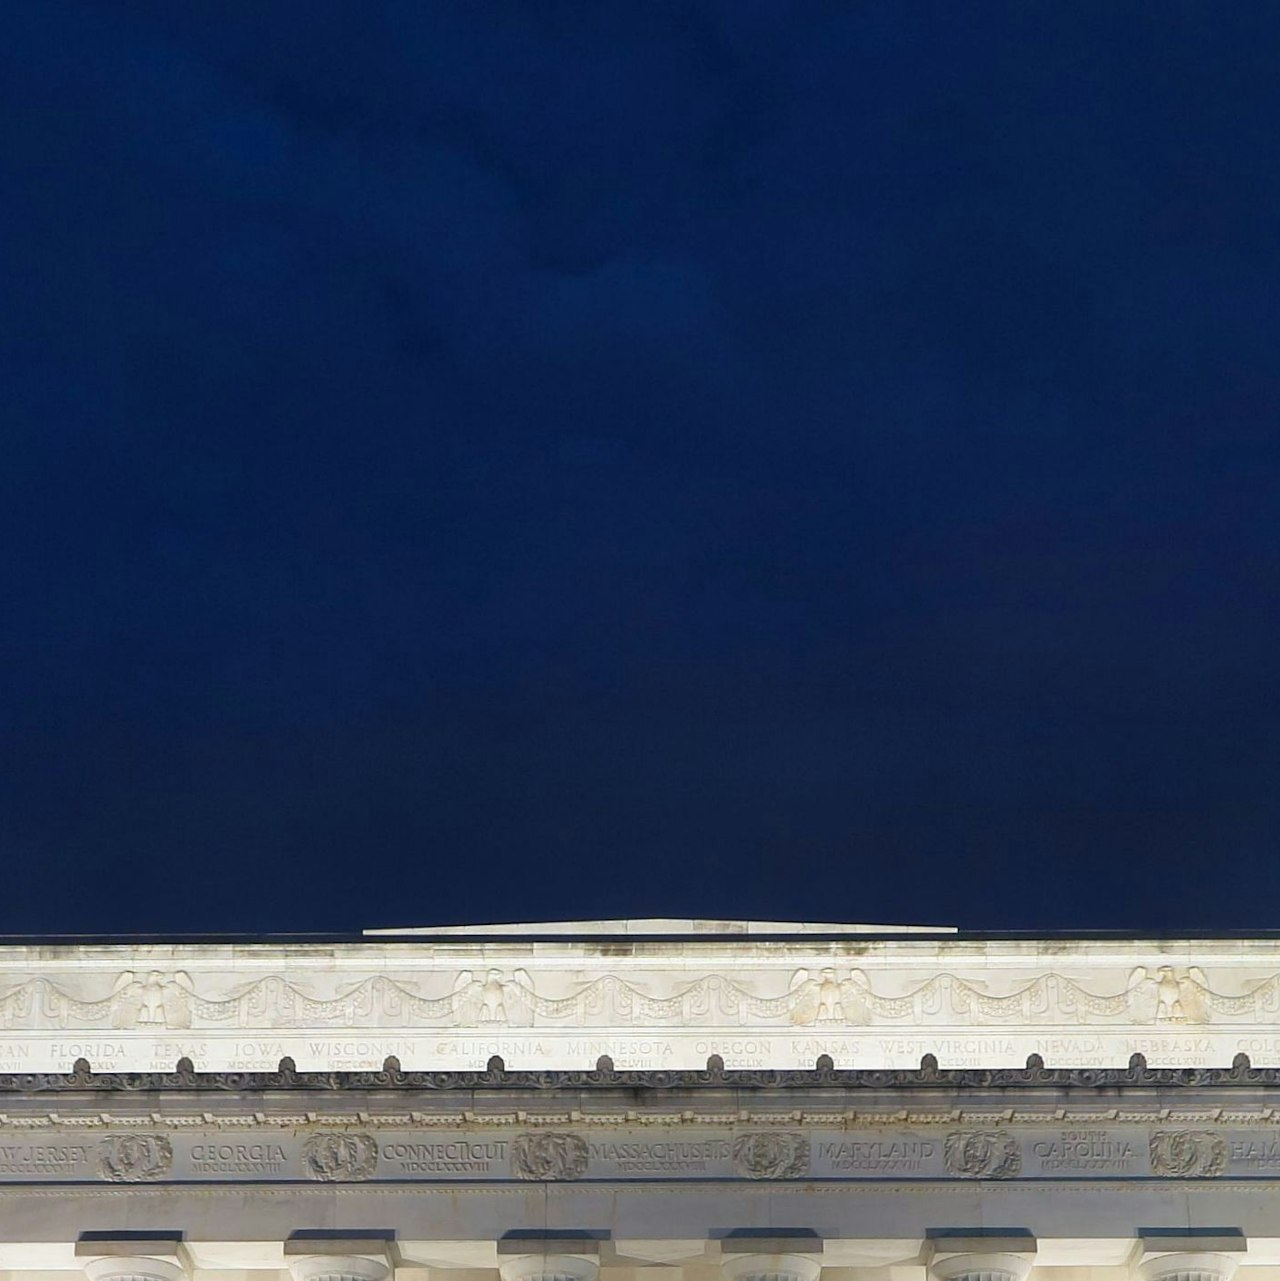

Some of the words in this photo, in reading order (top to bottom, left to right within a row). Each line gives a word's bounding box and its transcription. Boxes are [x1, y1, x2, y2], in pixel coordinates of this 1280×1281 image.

[50, 1044, 127, 1058] FLORIDA
[151, 1043, 208, 1057] TEXAS
[235, 1043, 286, 1057] IOWA
[309, 1042, 416, 1056] WISCONSIN
[436, 1041, 545, 1056] CALIFORNIA
[567, 1041, 674, 1055] MINNESOTA
[695, 1041, 770, 1055] OREGON
[792, 1041, 860, 1054] KANSAS
[878, 1040, 925, 1054] WEST
[932, 1040, 1016, 1054] VIRGINIA
[1036, 1039, 1106, 1053] NEVADA
[1126, 1039, 1215, 1053] NEBRASKA
[1061, 1131, 1107, 1141] SOUTH
[23, 1146, 92, 1164] JERSEY
[190, 1145, 287, 1162] GEORGIA
[382, 1141, 508, 1161] CONNECTICUT
[818, 1142, 935, 1159] MARYLAND
[1033, 1141, 1132, 1158] CAROLINA
